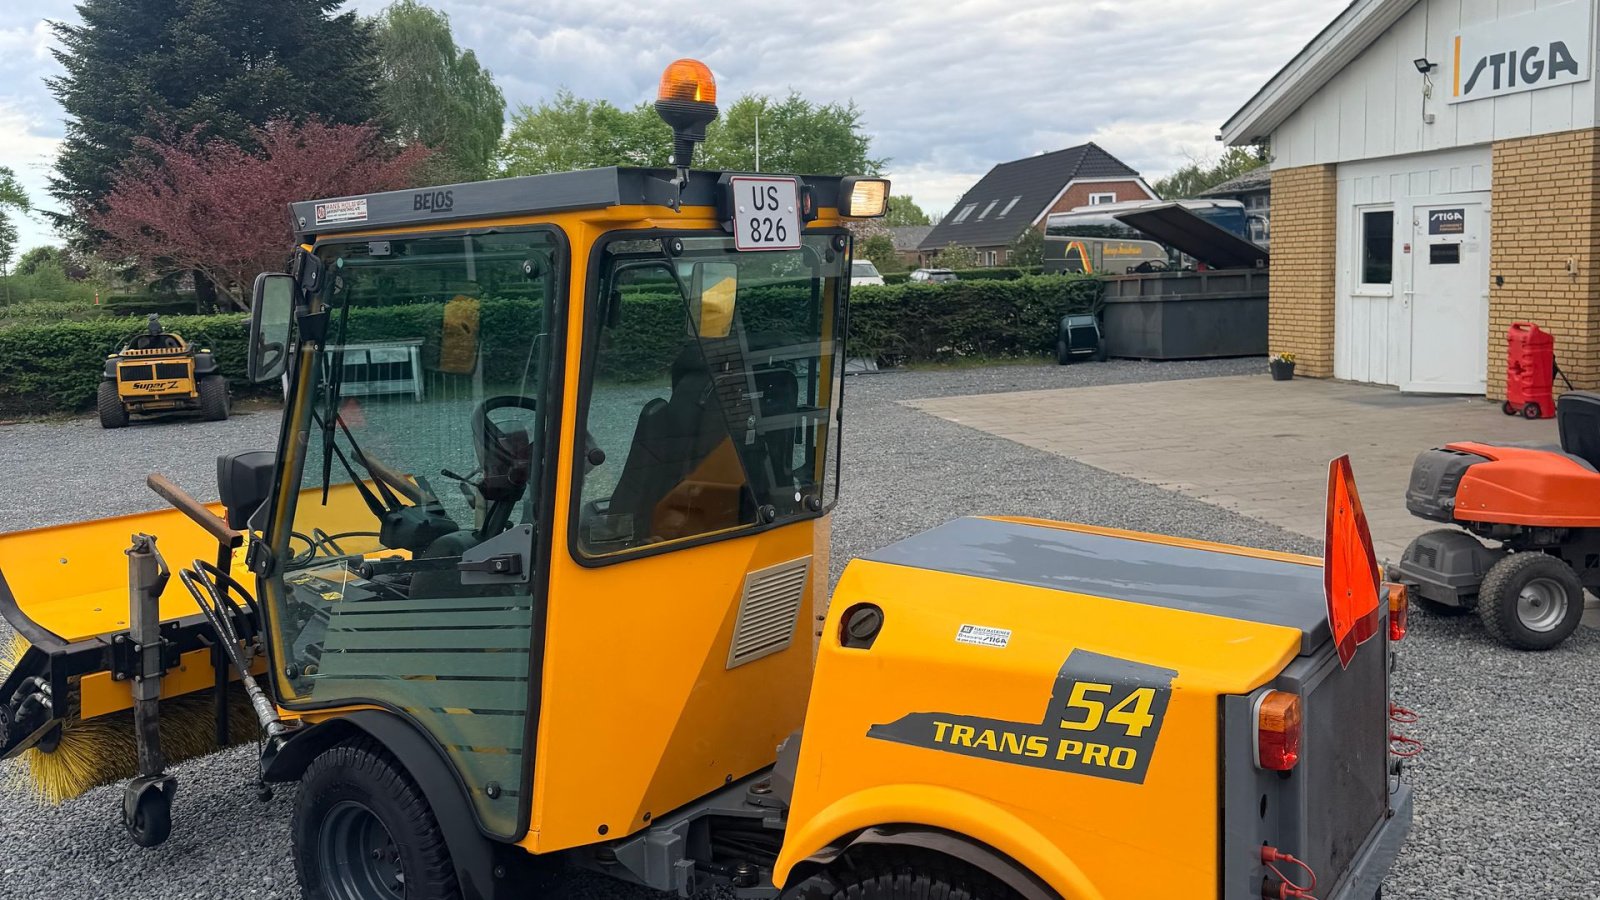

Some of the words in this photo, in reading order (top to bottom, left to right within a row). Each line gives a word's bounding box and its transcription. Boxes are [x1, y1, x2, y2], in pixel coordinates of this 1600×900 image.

[1463, 40, 1579, 96] STIGA
[413, 190, 454, 213] BELOS
[752, 185, 779, 211] US
[1430, 212, 1463, 221] STIGA
[750, 217, 787, 243] 826
[133, 382, 166, 390] Super
[167, 381, 178, 390] Z
[983, 636, 1007, 644] STIGA
[1060, 681, 1157, 738] 54
[932, 721, 1049, 758] TRANS
[1055, 739, 1138, 770] PRO
